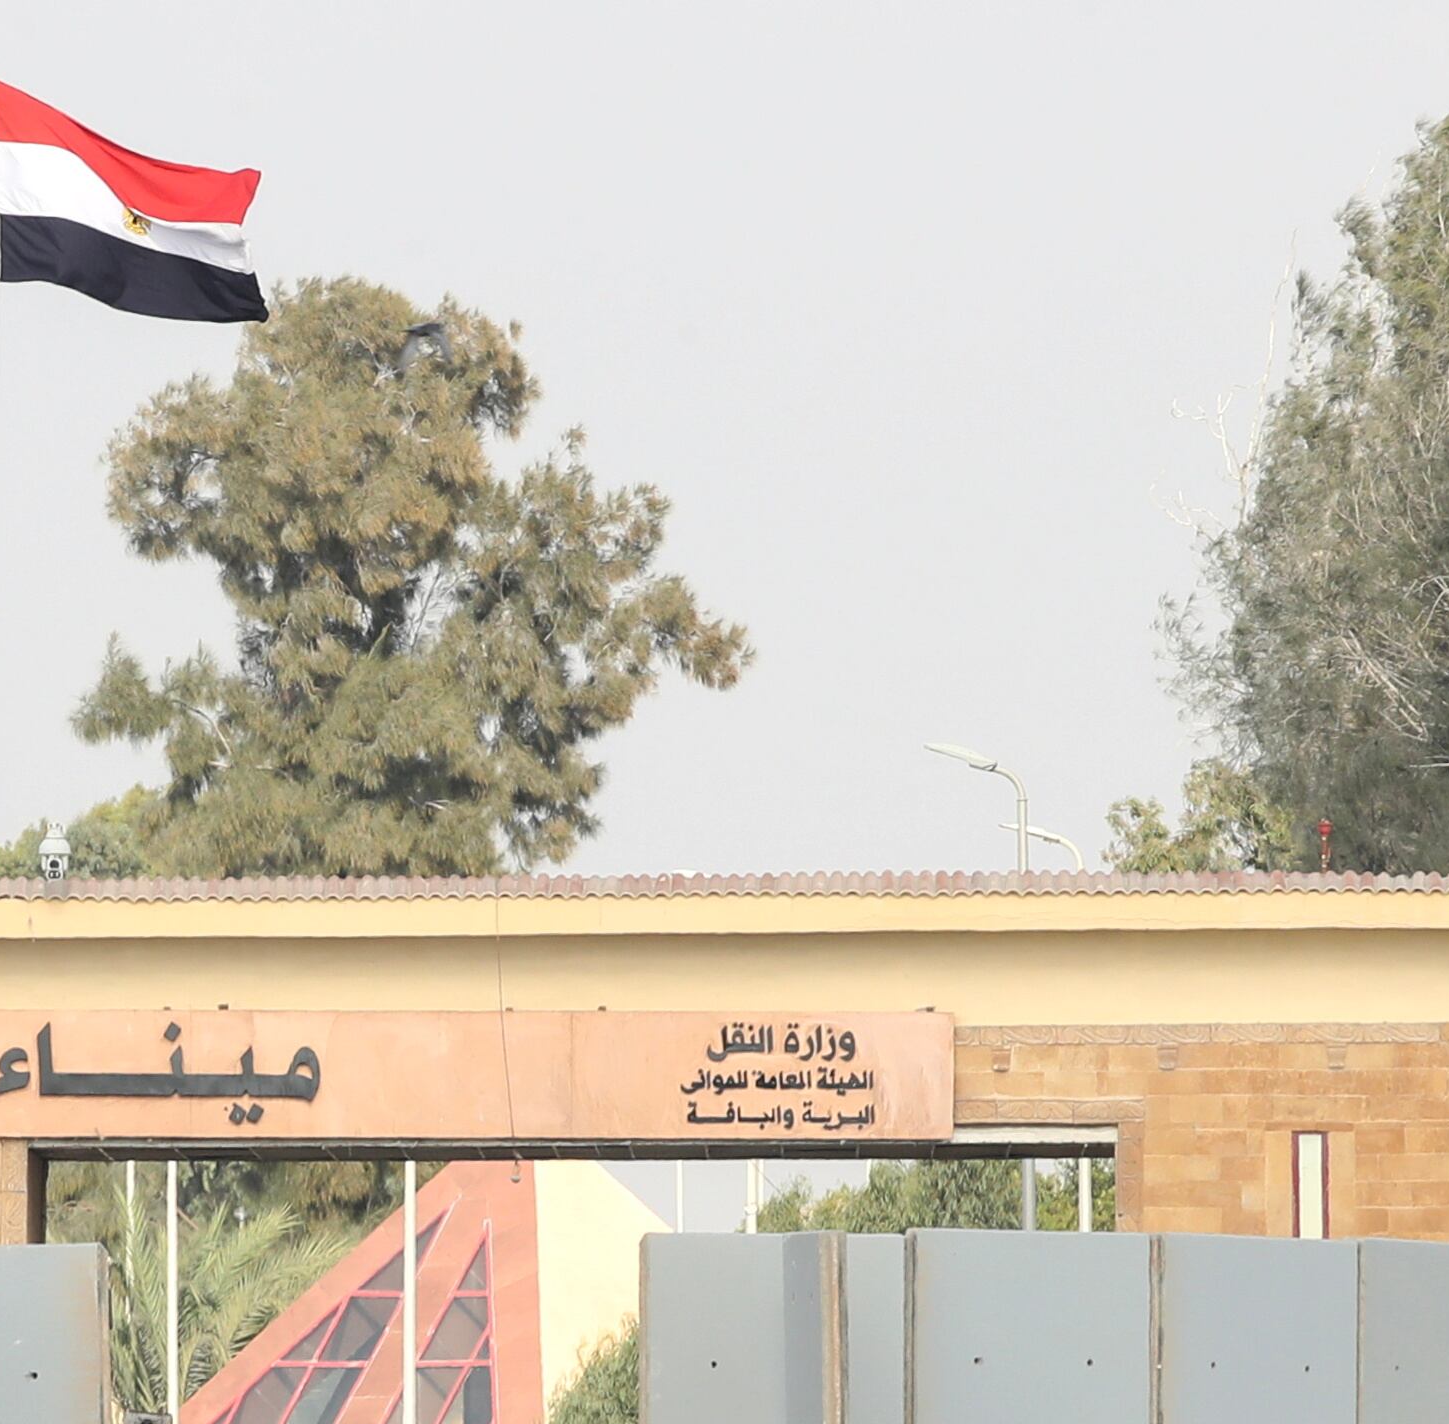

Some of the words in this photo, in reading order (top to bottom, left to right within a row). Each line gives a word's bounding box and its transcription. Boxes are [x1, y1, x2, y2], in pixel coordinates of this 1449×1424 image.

[707, 1022, 773, 1063] النقل
[784, 1022, 856, 1062] وزارة
[752, 1069, 811, 1090] العامة
[817, 1066, 874, 1096] الهيئة
[686, 1101, 794, 1130] والجافة
[802, 1101, 876, 1131] البرية
